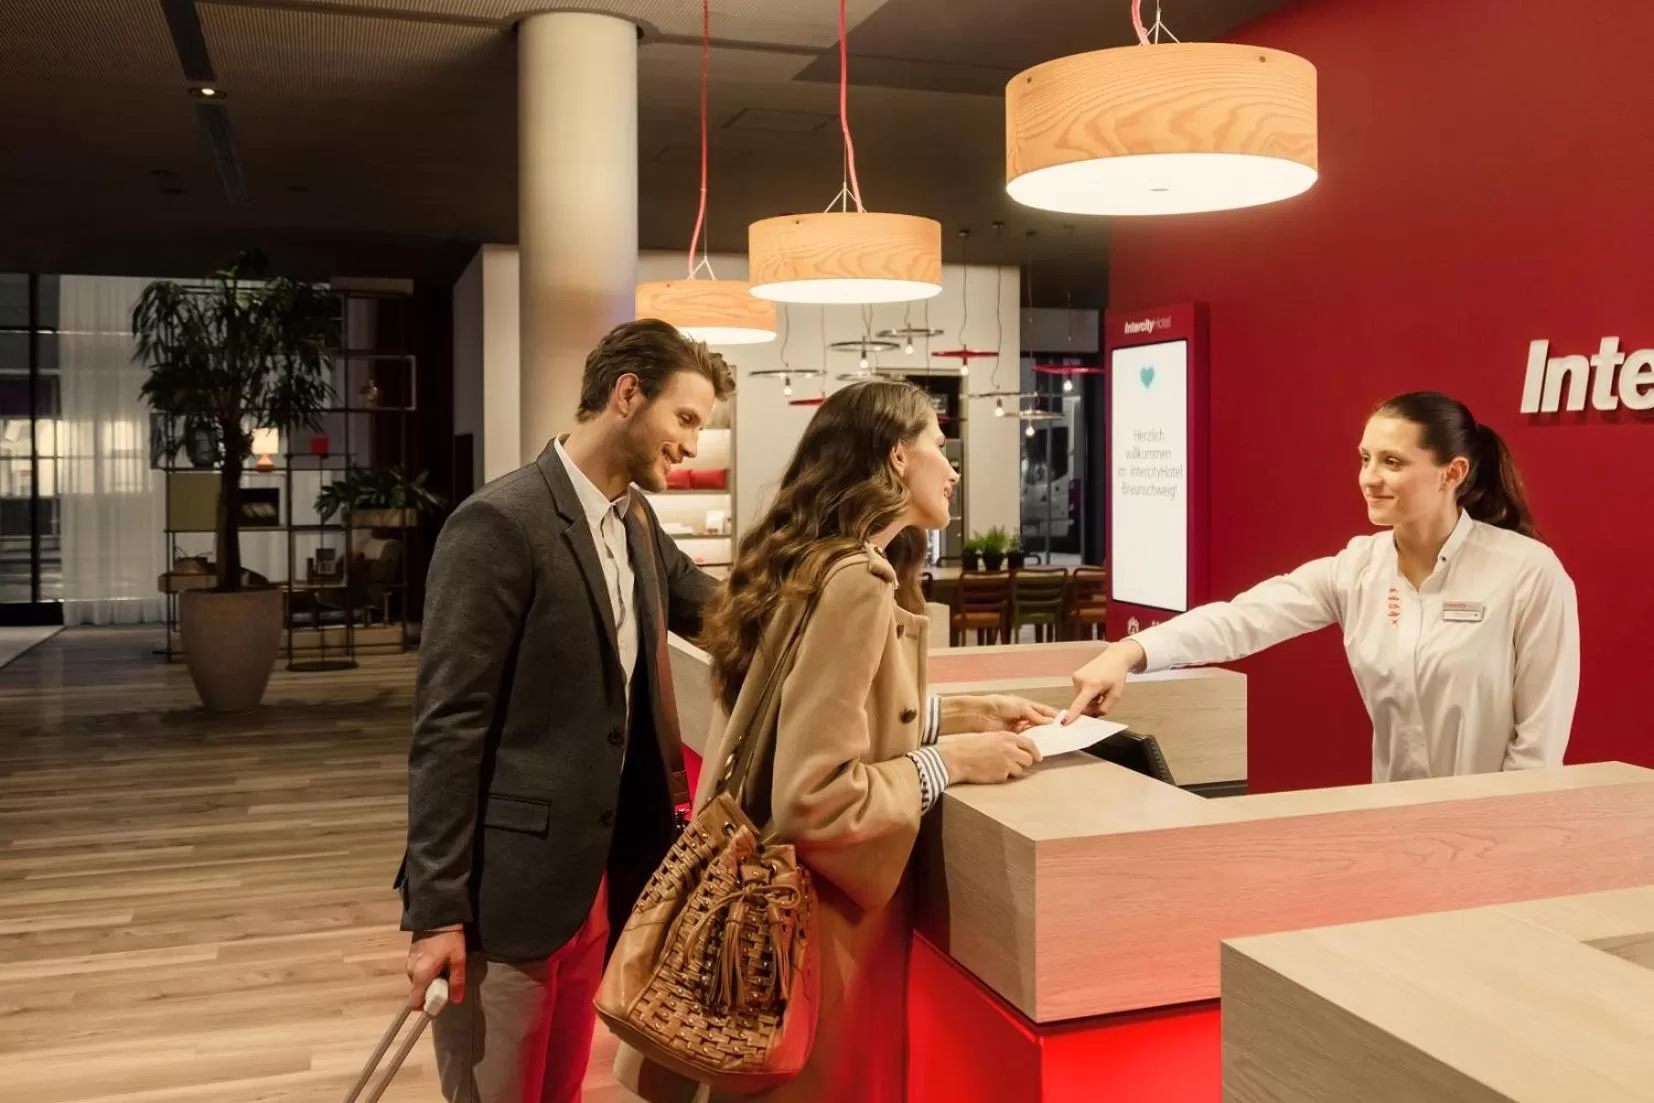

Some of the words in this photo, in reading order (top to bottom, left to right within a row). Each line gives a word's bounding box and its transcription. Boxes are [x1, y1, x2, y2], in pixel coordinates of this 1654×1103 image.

[1124, 316, 1172, 334] IntercityHotel
[1520, 336, 1654, 414] Inte
[1133, 428, 1165, 442] Herzlich
[1125, 444, 1172, 460] willkommen
[1130, 463, 1183, 480] IntercityHotel
[1121, 481, 1178, 501] Braunschweig!
